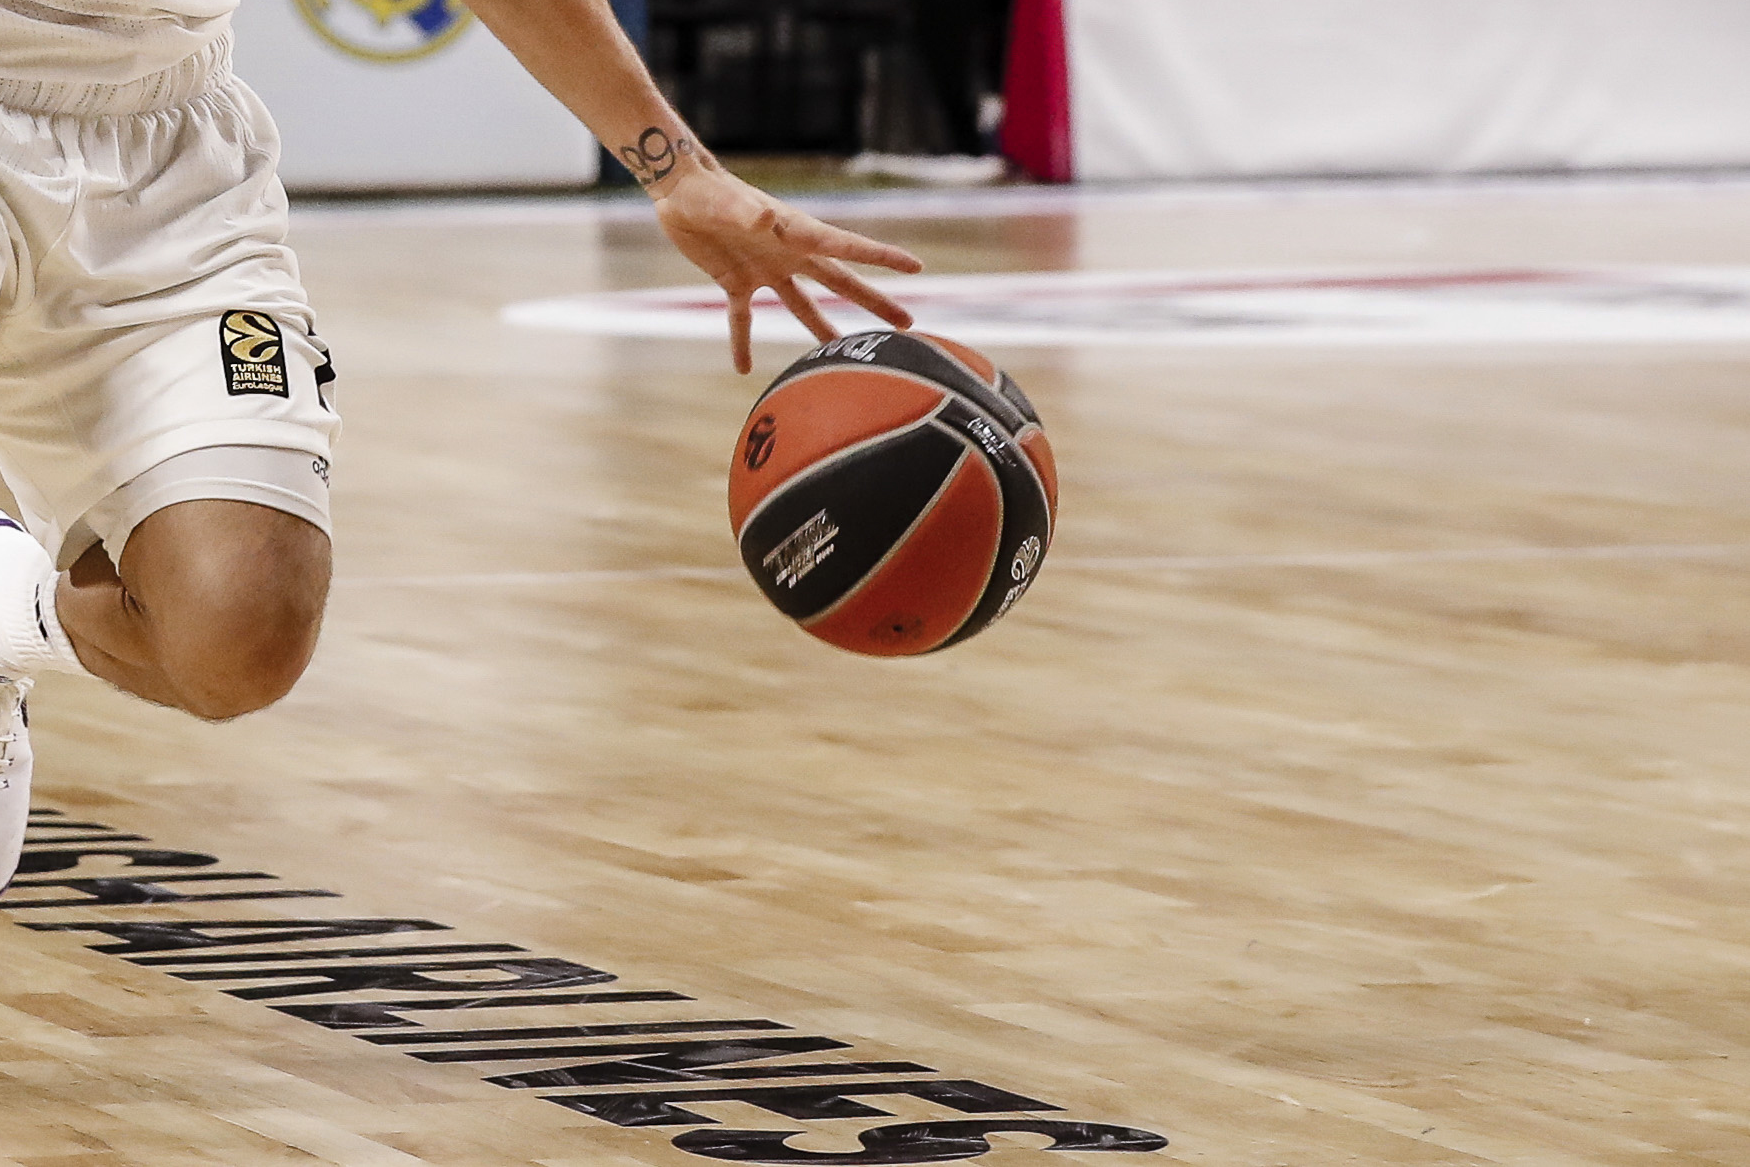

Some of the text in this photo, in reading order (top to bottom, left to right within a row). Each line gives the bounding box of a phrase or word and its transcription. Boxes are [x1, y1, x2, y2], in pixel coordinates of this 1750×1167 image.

[230, 363, 281, 375] TURKISH
[232, 372, 283, 383] AIRLINES
[14, 917, 1170, 1167] AIRLINES
